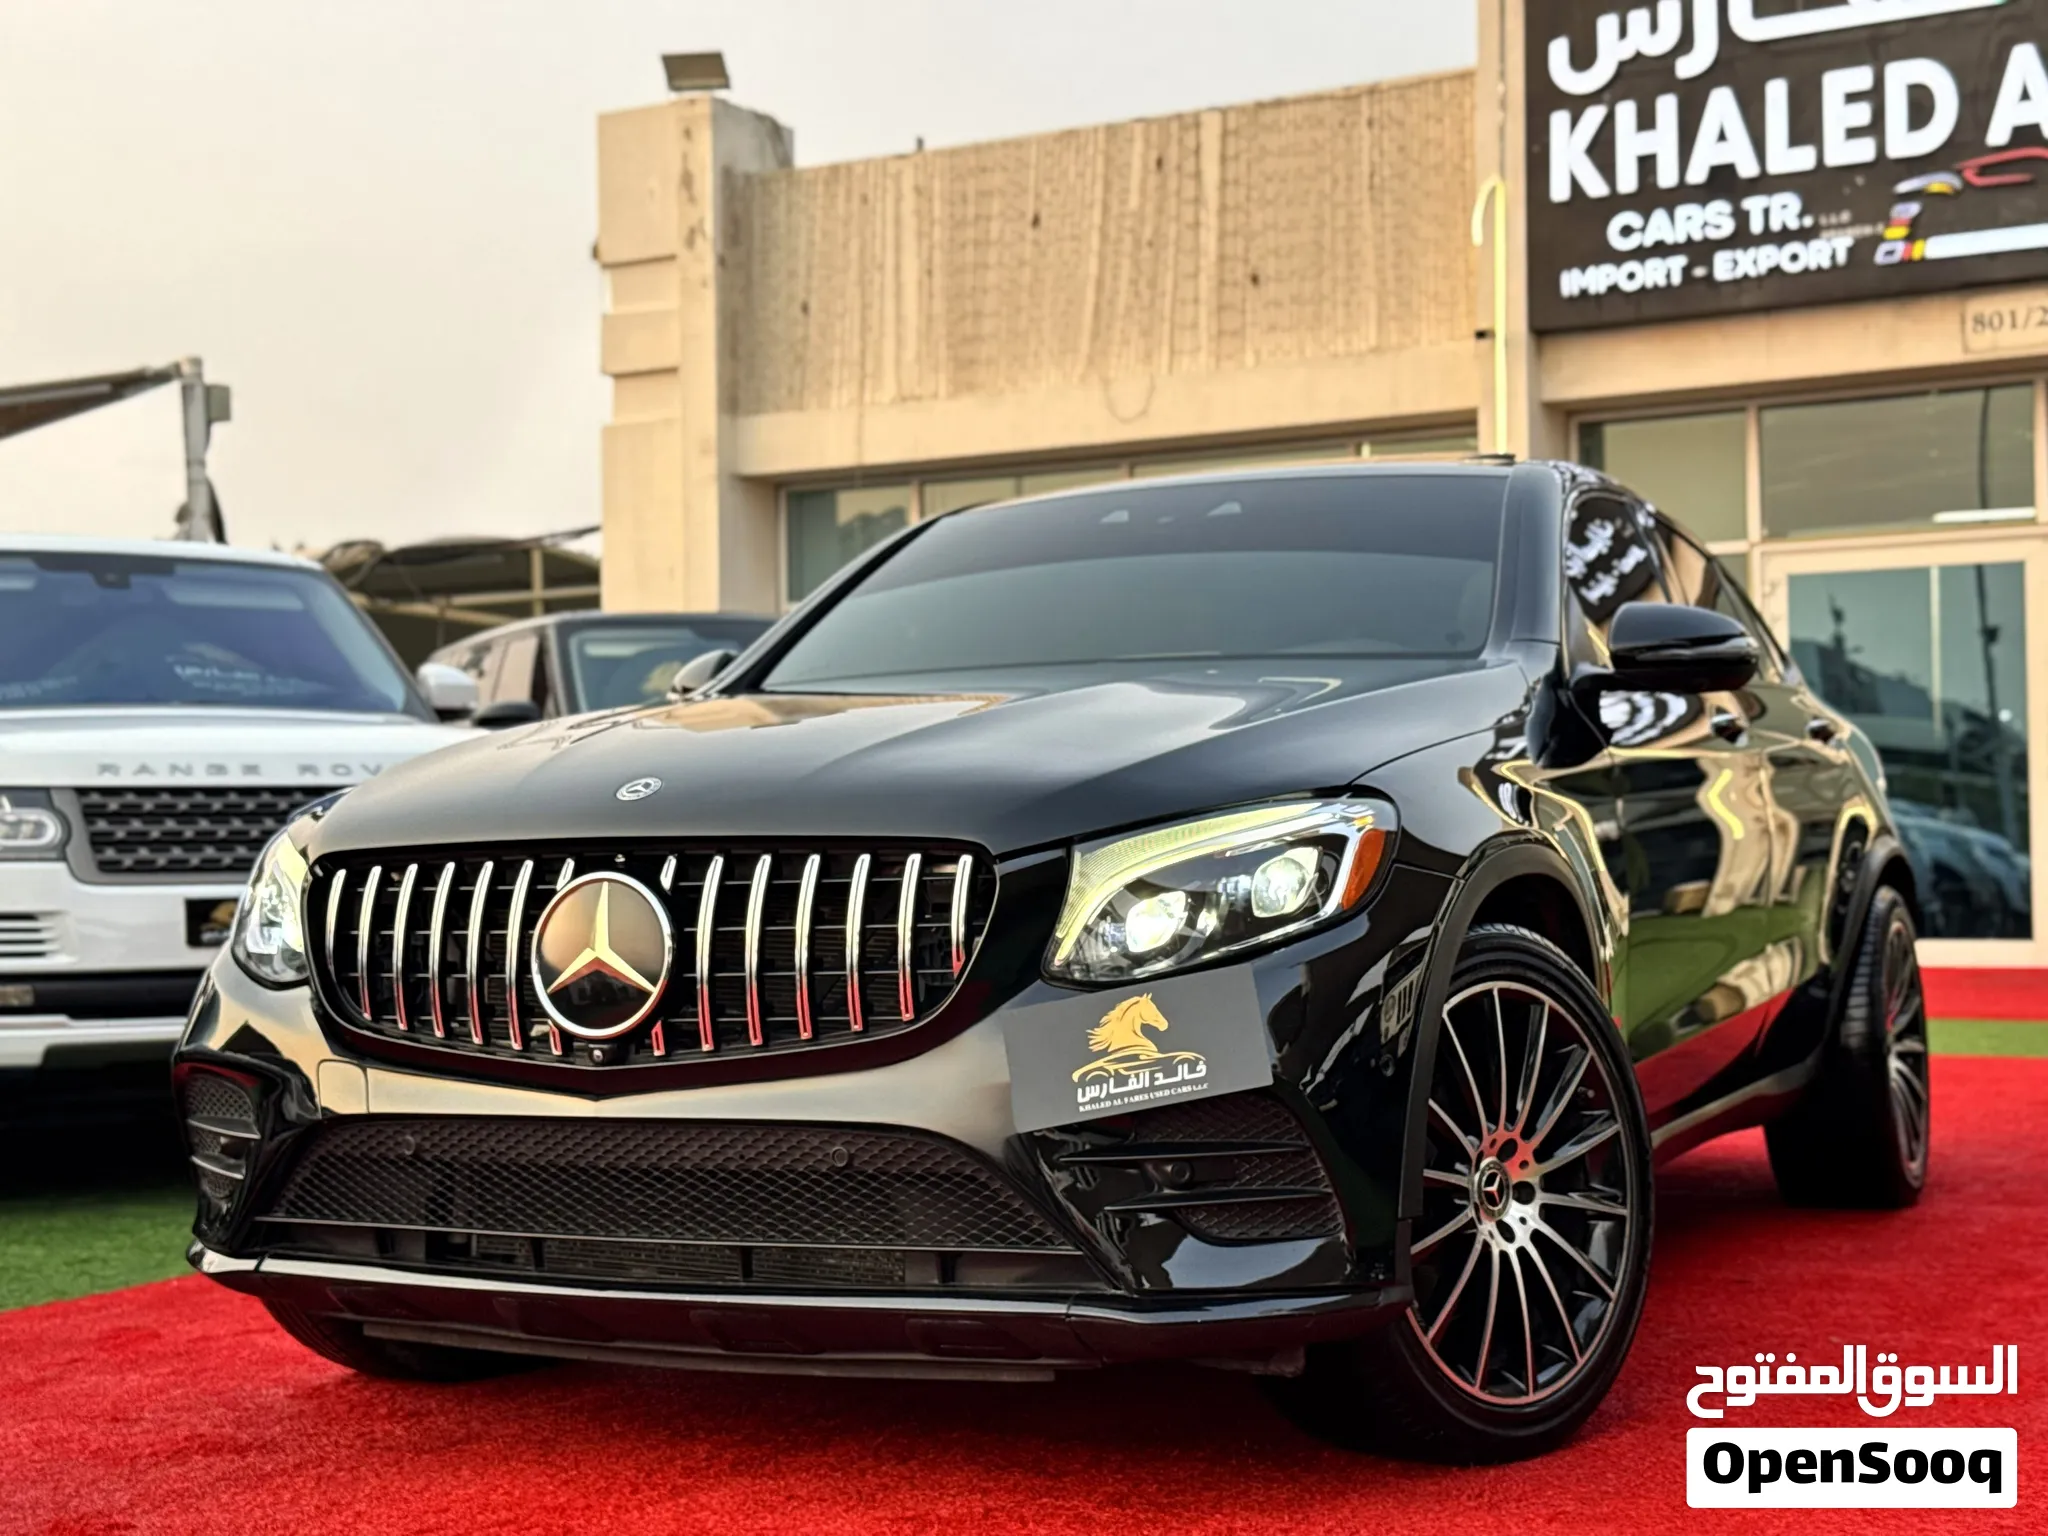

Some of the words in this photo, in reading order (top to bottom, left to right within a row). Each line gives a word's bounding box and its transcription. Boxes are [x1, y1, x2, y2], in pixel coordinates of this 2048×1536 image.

[1548, 57, 1961, 204] KHALED
[1605, 198, 1737, 252] CARS
[1740, 191, 1815, 236] TR.
[1558, 253, 1688, 299] IMPORT
[1712, 236, 1856, 283] EXPORT
[97, 762, 262, 777] RANGE
[297, 762, 384, 777] ROV
[1077, 1070, 1150, 1104] الفارس
[1153, 1060, 1207, 1086] خالد
[1079, 1100, 1113, 1113] KHALED
[1113, 1097, 1123, 1106] AL
[1123, 1092, 1150, 1104] FARES
[1149, 1089, 1170, 1099] USED
[1171, 1084, 1194, 1095] CARS
